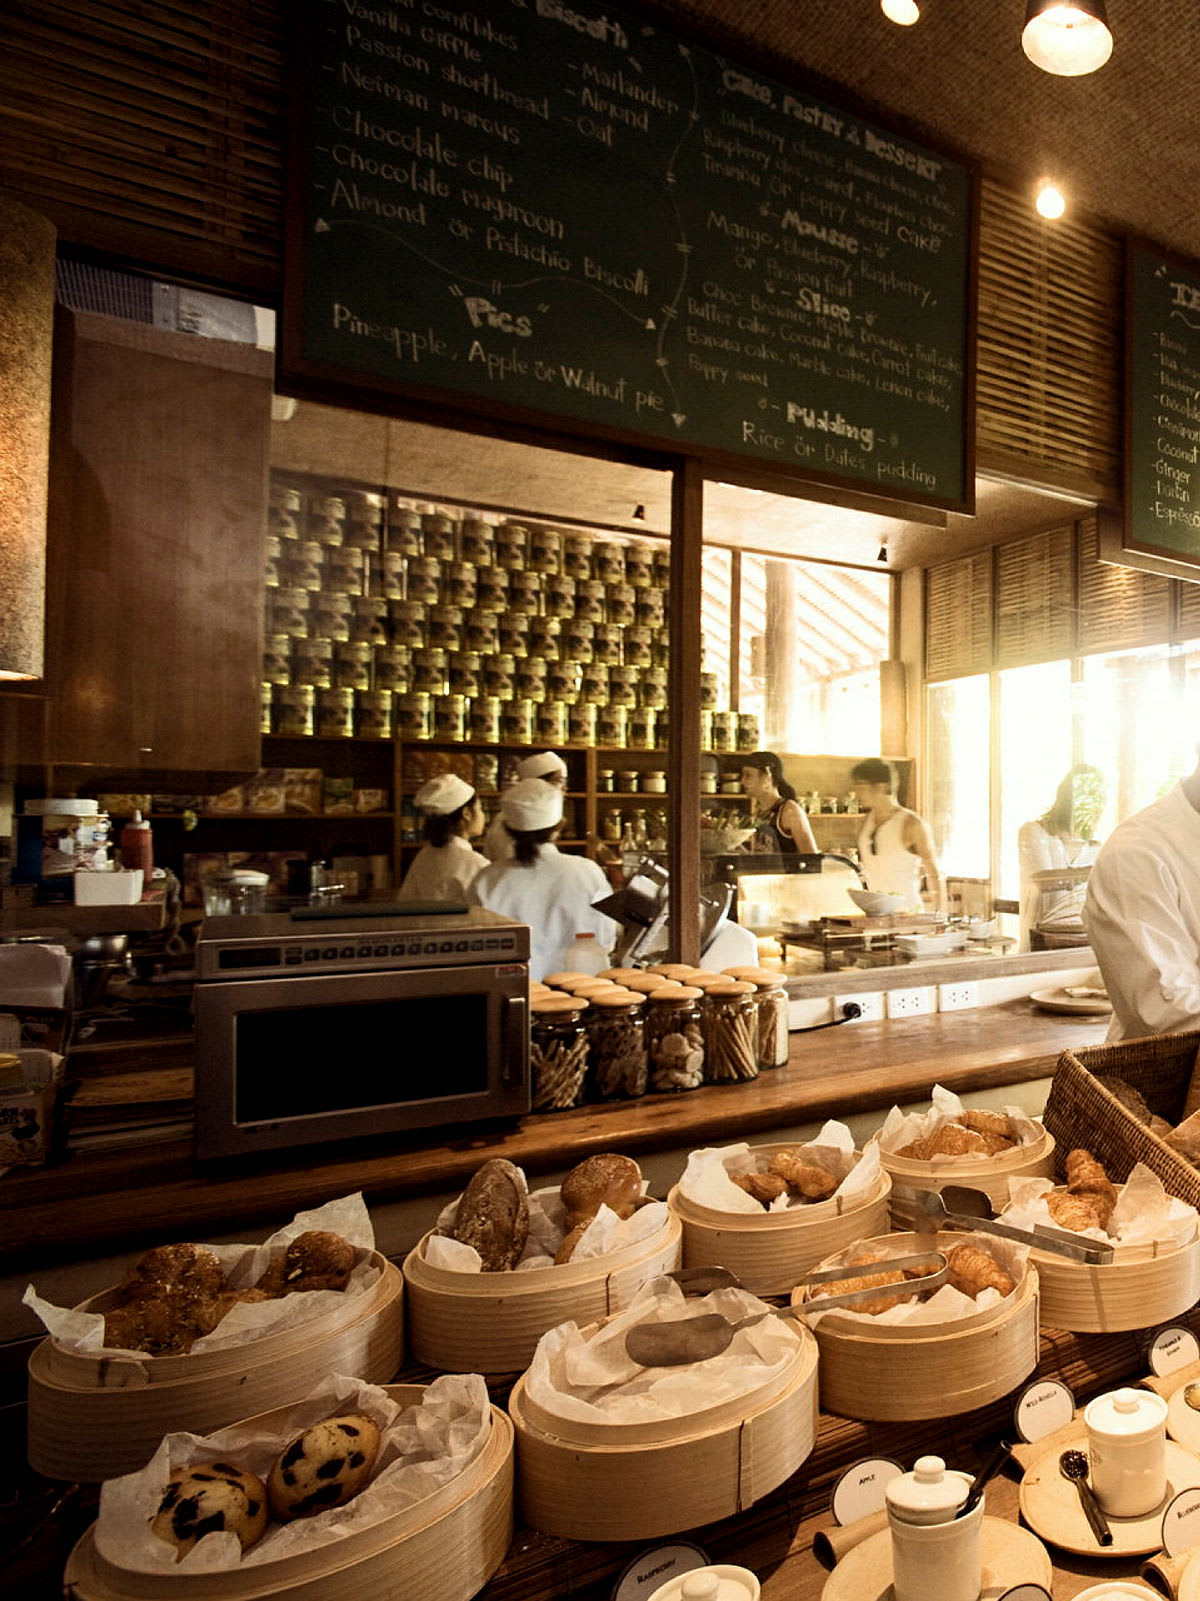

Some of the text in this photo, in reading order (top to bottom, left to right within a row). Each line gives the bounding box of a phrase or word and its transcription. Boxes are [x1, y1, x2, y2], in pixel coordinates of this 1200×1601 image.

[346, 24, 430, 74] Passion
[332, 142, 450, 198] Chocolate
[333, 105, 514, 193] Chocolate chip
[331, 177, 427, 226] Almond
[559, 364, 627, 403] Walnut
[635, 390, 664, 417] pie
[742, 420, 786, 451] Rice
[876, 459, 938, 492] pudding
